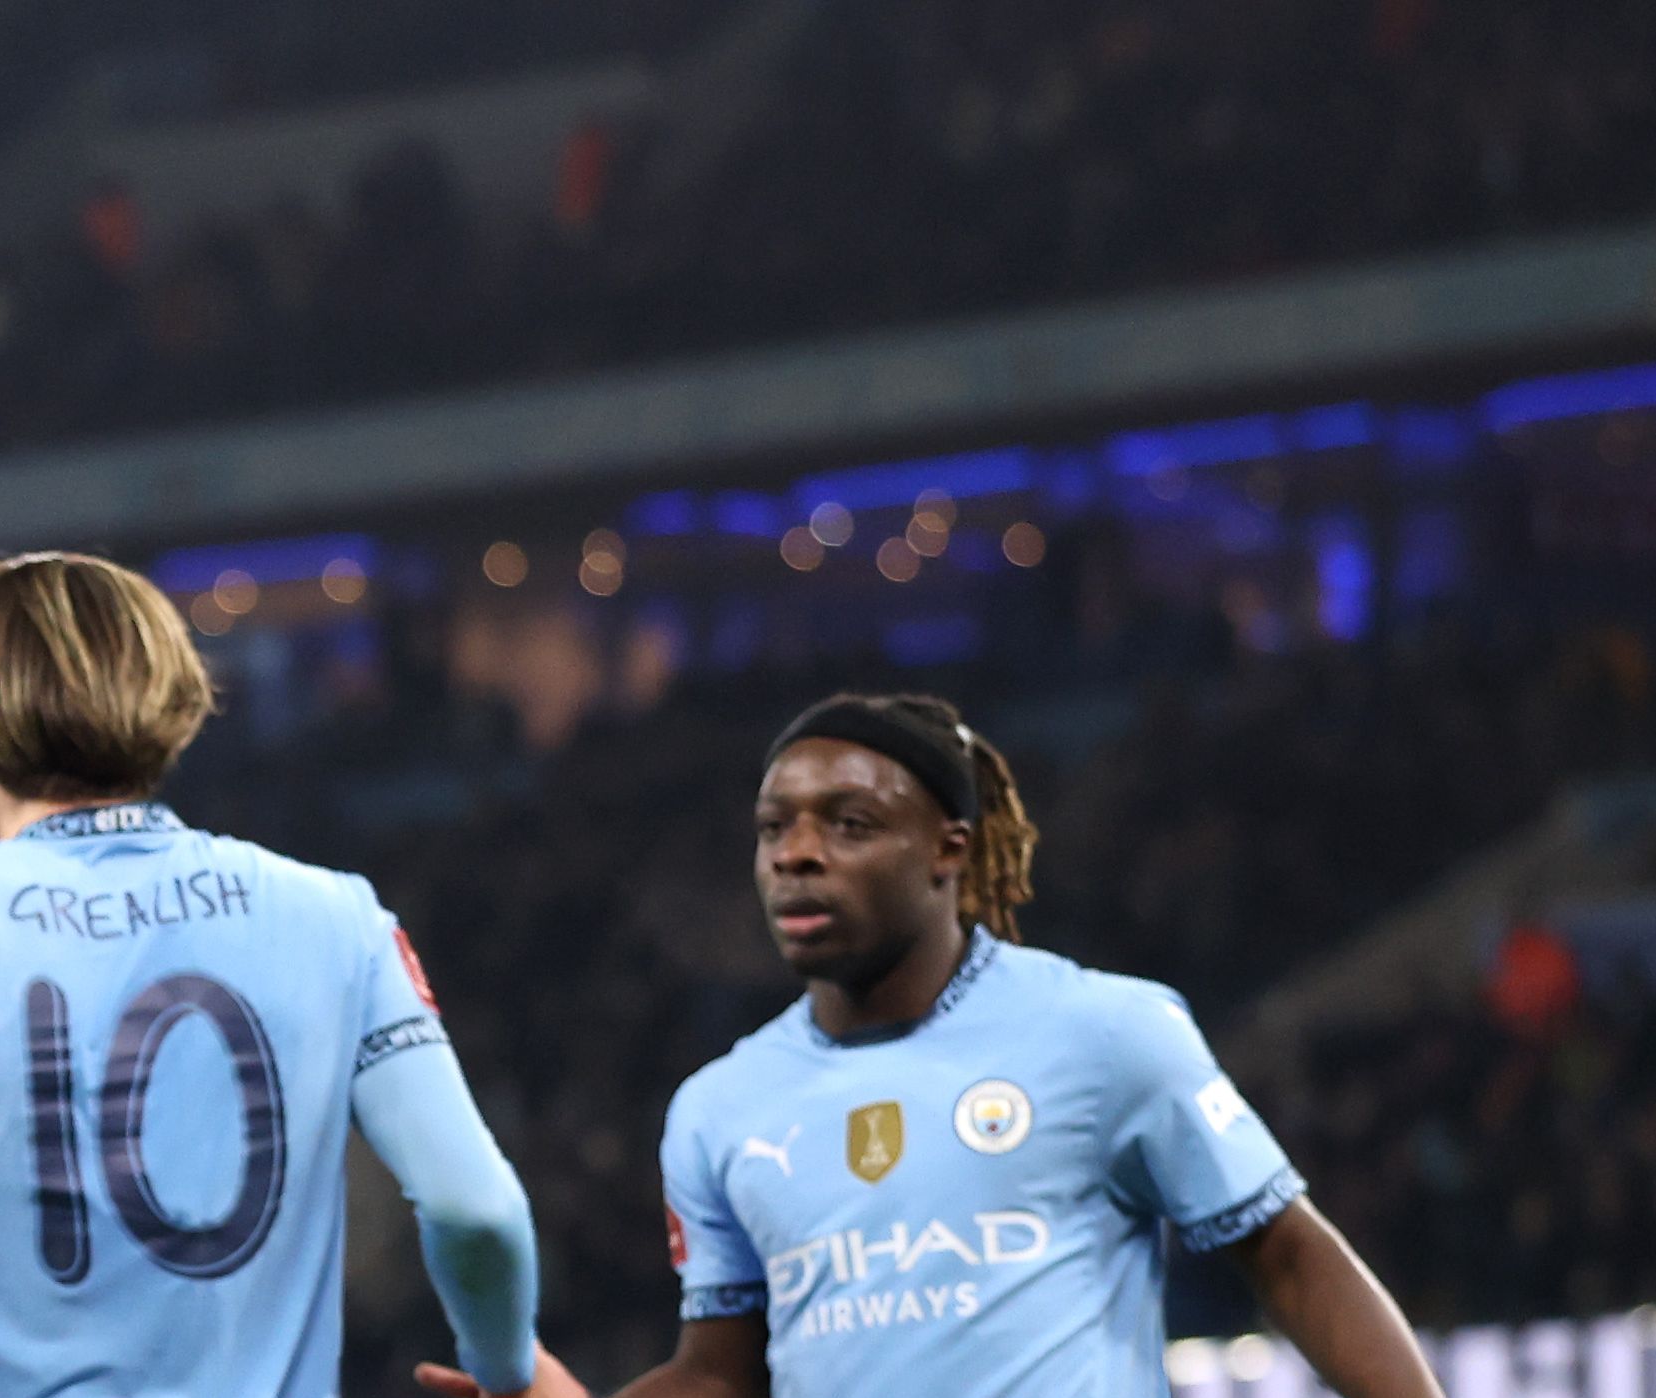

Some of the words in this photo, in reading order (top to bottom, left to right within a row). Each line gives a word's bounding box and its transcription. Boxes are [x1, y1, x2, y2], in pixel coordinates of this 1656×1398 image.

[7, 868, 251, 940] GREALISH
[27, 969, 285, 1286] 10
[800, 1280, 980, 1338] AIRWAYS
